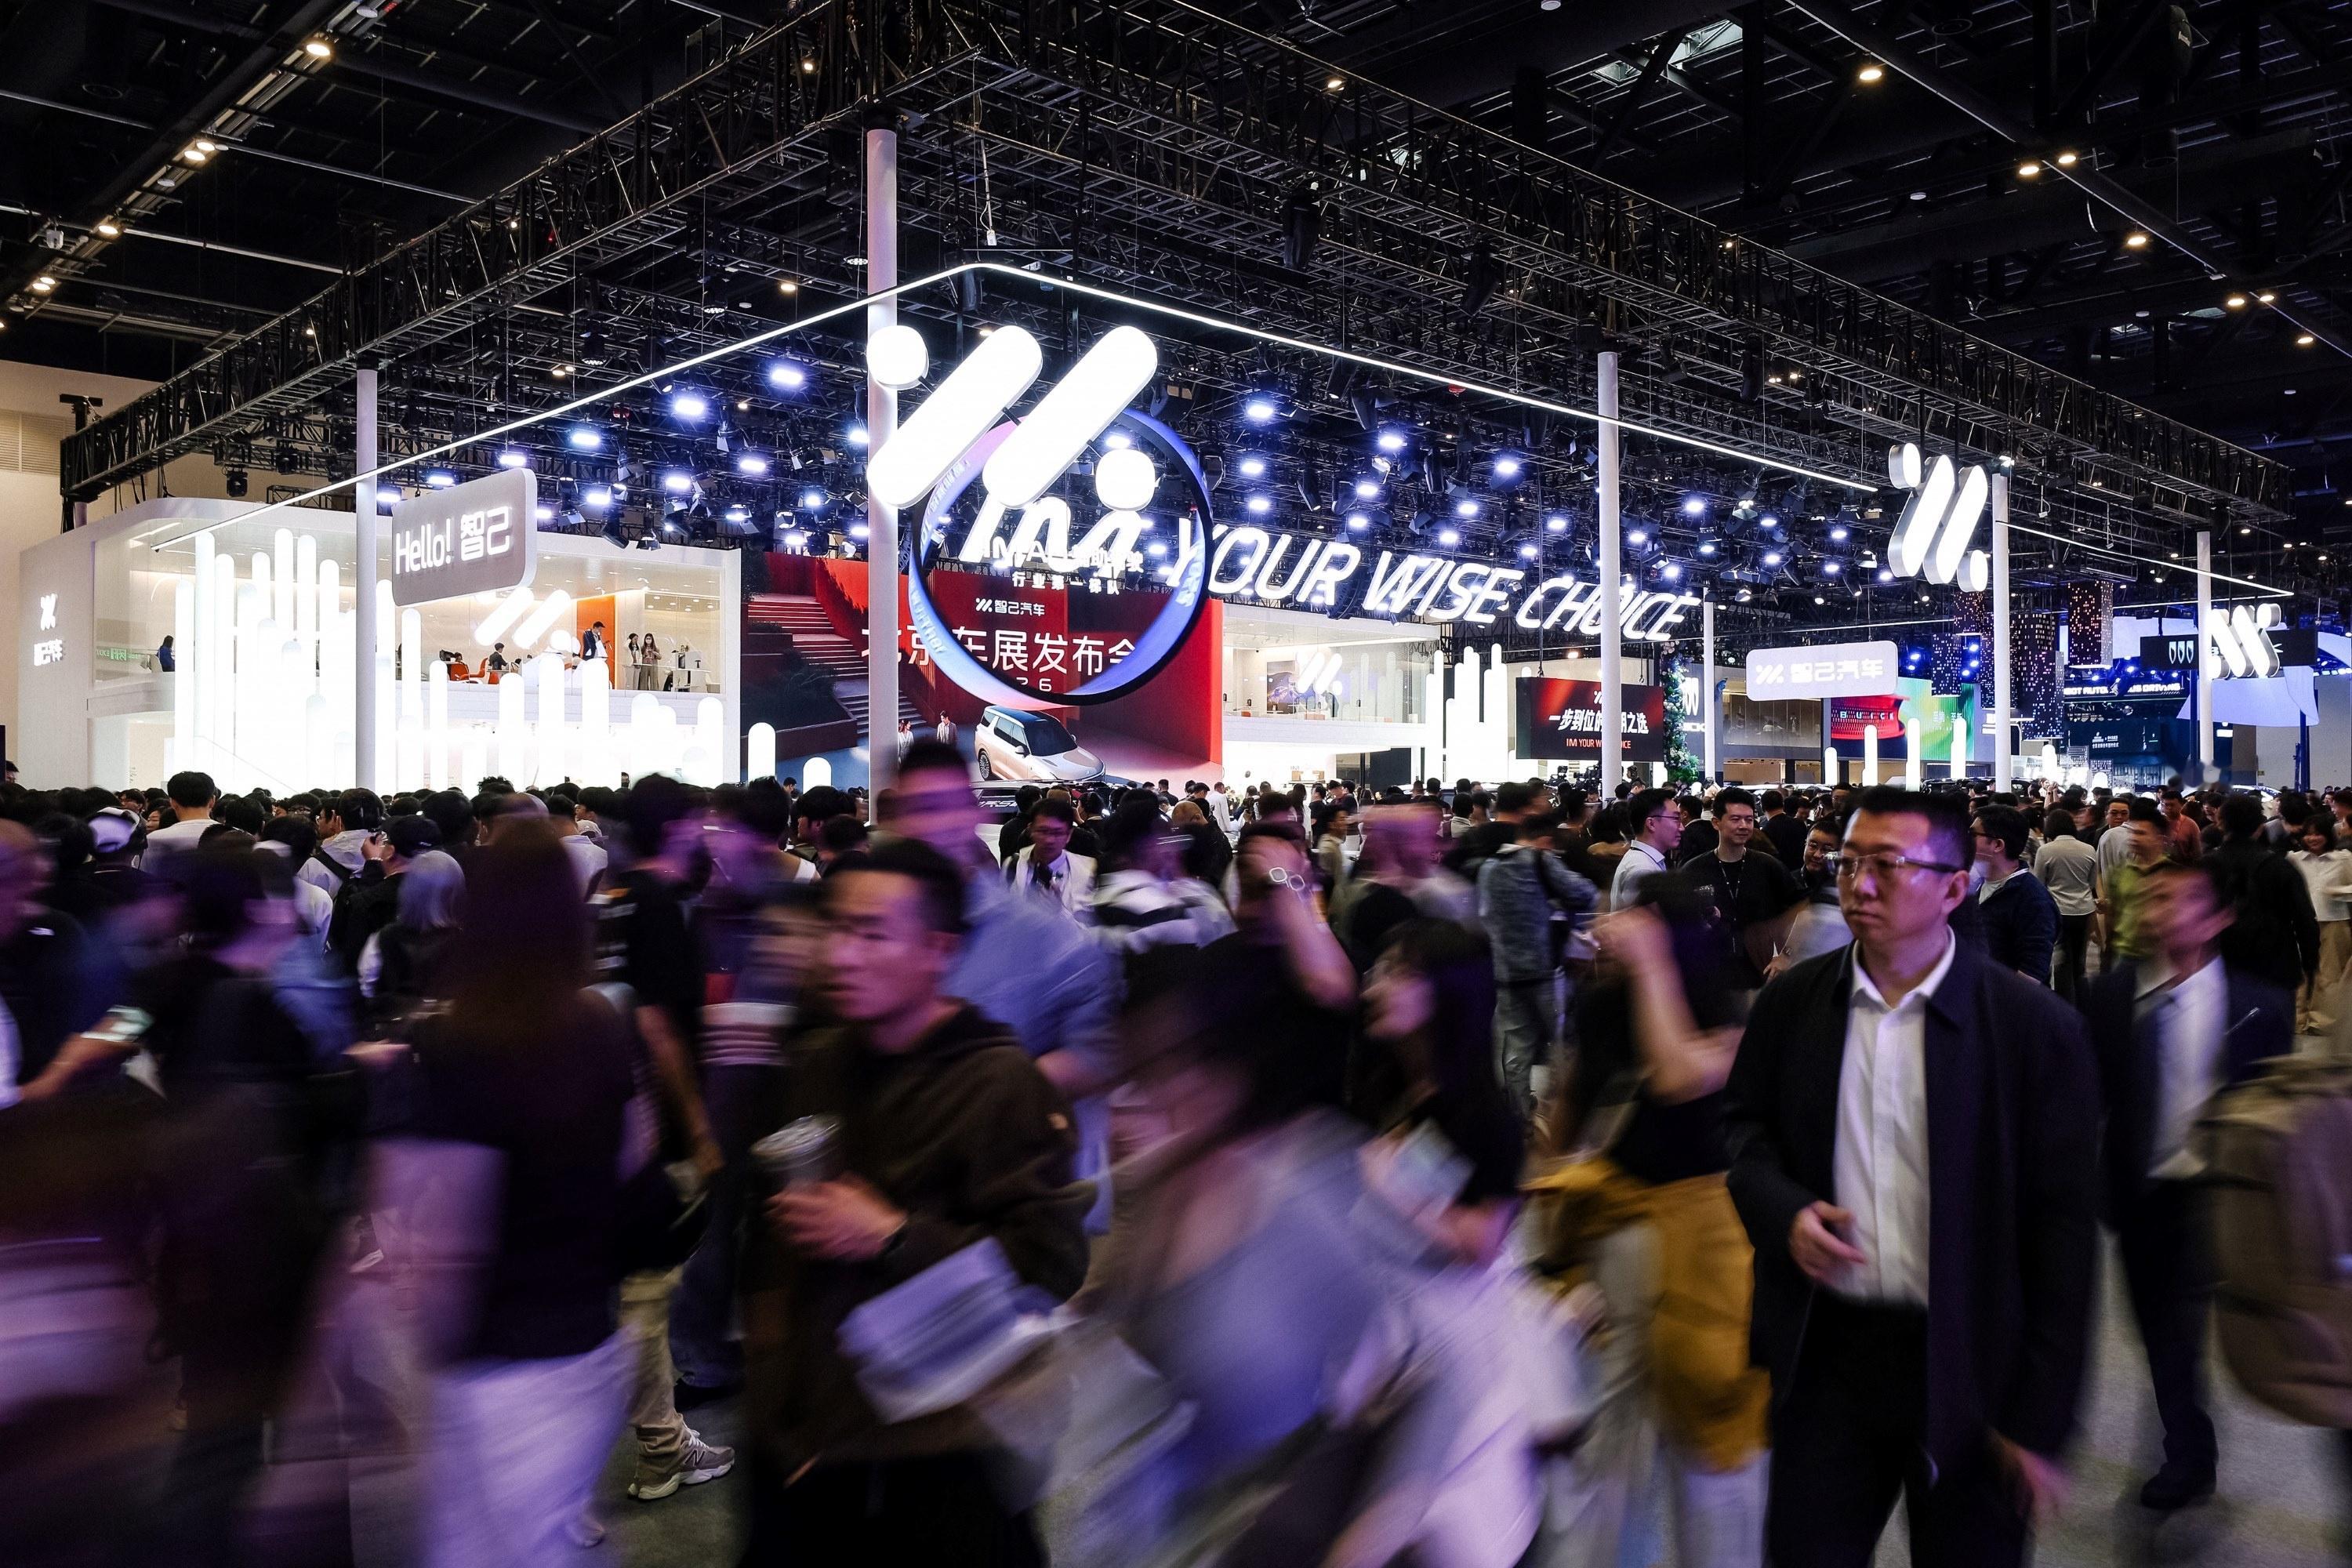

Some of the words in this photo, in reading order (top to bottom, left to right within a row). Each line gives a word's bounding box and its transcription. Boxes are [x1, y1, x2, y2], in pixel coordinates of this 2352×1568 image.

[395, 518, 451, 575] Hello!
[461, 506, 510, 561] 智己
[1166, 517, 1360, 605] YOUR
[1363, 550, 1525, 624] WISE
[1515, 576, 1701, 641] CHOICE
[994, 599, 1045, 617] 智己汽车
[1548, 709, 1649, 734] 一步到位的之选
[1840, 710, 1894, 721] BUICK
[1566, 738, 1577, 747] IM
[1579, 739, 1595, 748] YOUR
